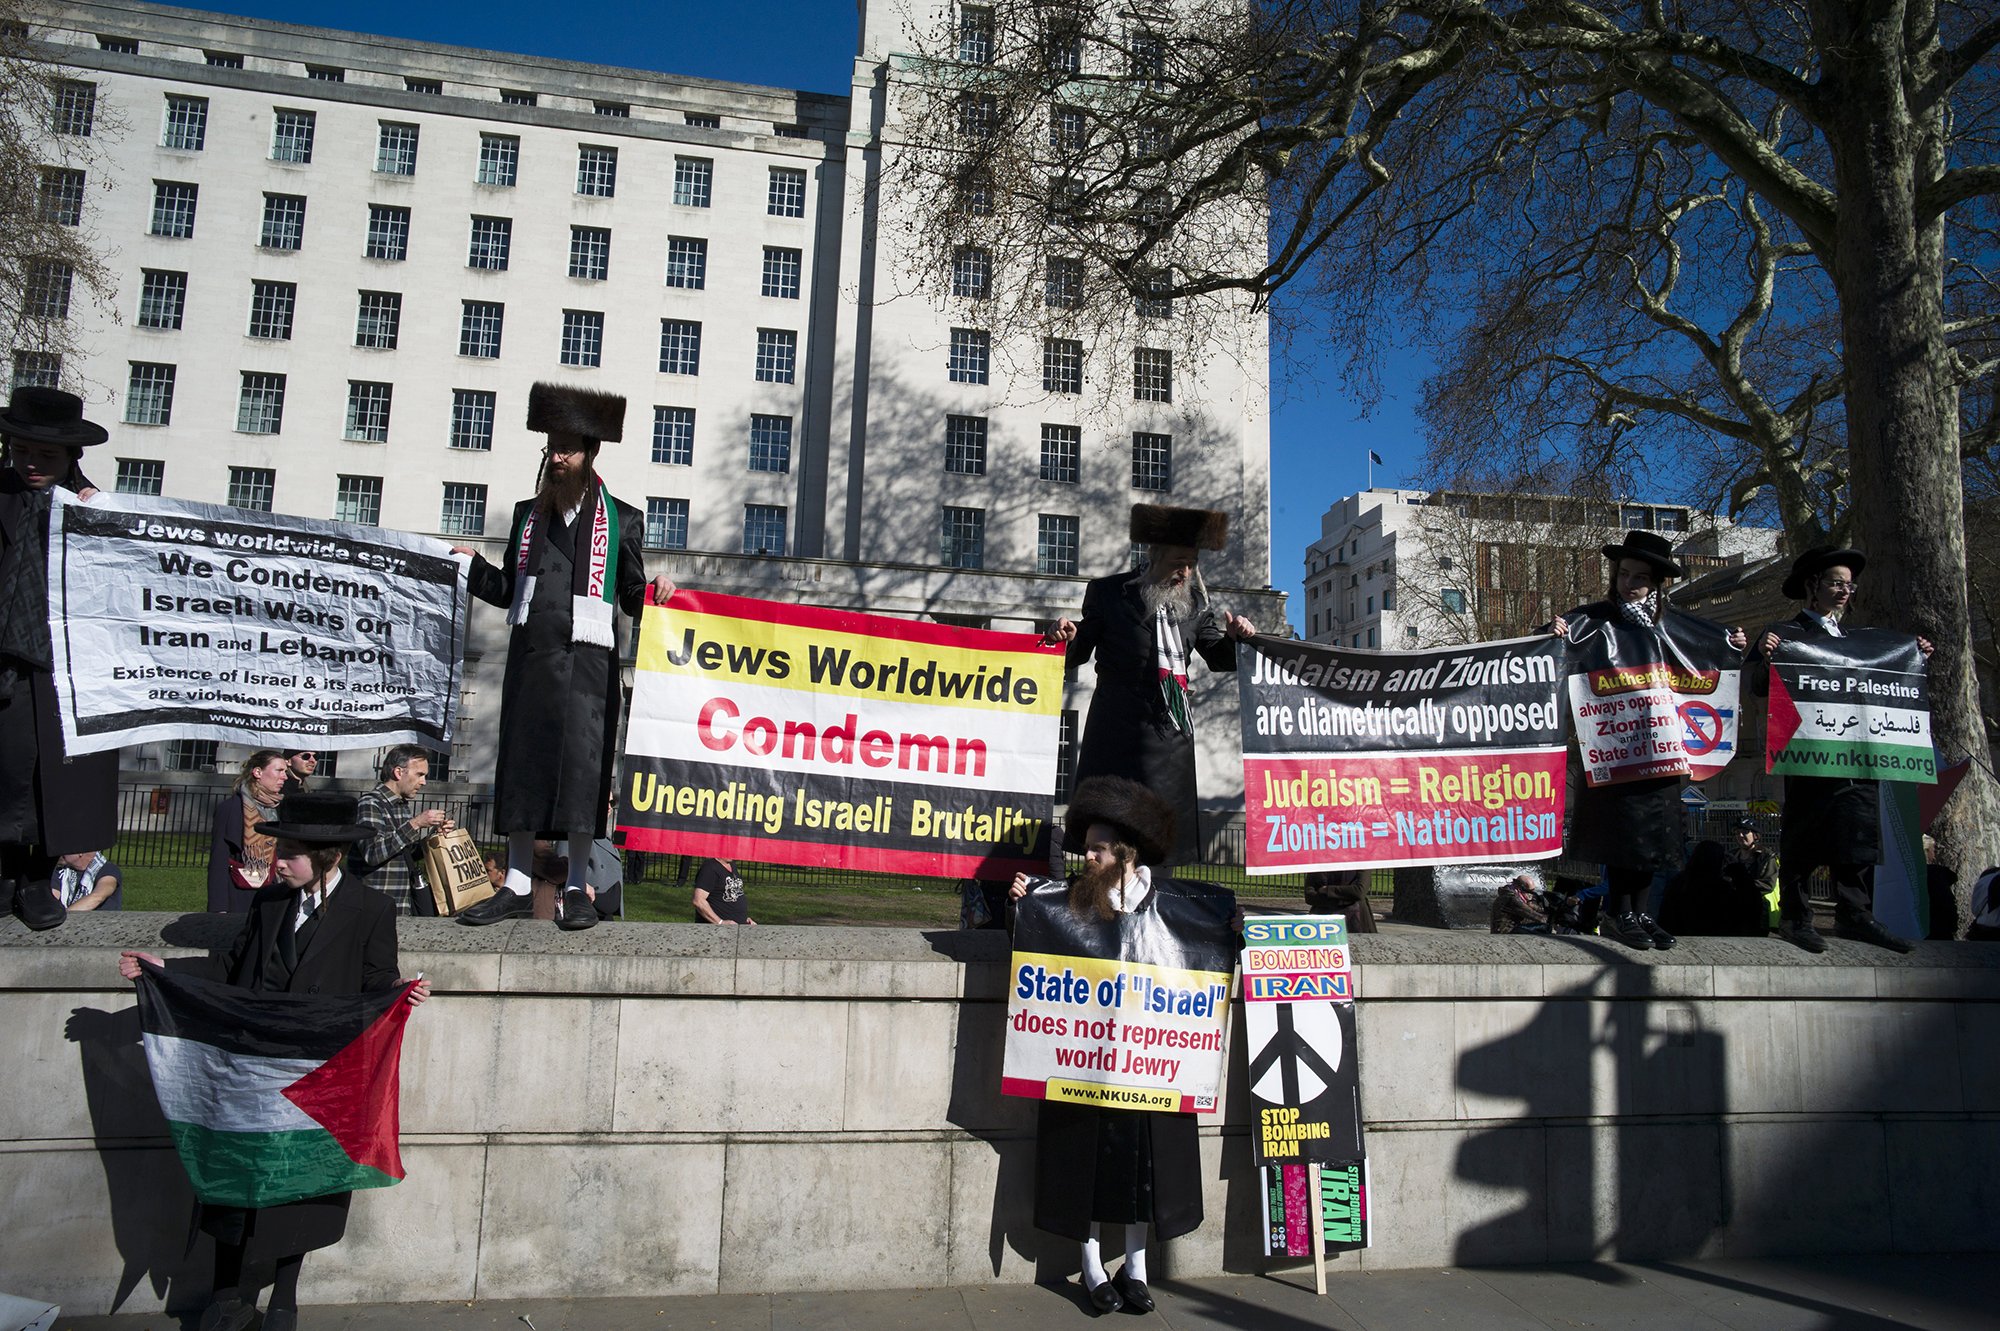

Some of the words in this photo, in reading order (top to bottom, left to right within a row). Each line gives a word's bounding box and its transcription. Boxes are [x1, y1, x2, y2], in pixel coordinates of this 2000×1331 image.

[129, 520, 206, 541] Jews
[215, 531, 350, 560] worldwide
[158, 552, 213, 578] We
[226, 559, 379, 600] Condemn
[143, 588, 252, 616] Israeli
[264, 600, 345, 630] Wars
[356, 617, 391, 636] on
[140, 626, 209, 647] Iran
[217, 639, 252, 651] and
[260, 632, 393, 667] Lebanon
[667, 628, 791, 679] Jews
[809, 644, 1038, 705] Worldwide
[1252, 646, 1381, 691] Judaism
[1382, 659, 1444, 692] and
[1440, 651, 1556, 688] Zionism
[113, 666, 213, 680] Existence
[219, 670, 238, 682] of
[244, 670, 296, 688] Israel
[303, 676, 316, 689] &
[324, 678, 346, 690] its
[351, 682, 417, 695] actions
[1798, 675, 1840, 691] Free
[1846, 677, 1920, 699] Palestine
[149, 689, 180, 700] are
[187, 689, 279, 709] violations
[285, 698, 308, 710] of
[309, 698, 385, 712] Judaism
[1580, 699, 1626, 717] always
[210, 714, 328, 733] www.NKUSA.org
[1256, 704, 1293, 736] are
[1298, 697, 1446, 743] diametrically
[1452, 693, 1559, 741] opposed
[1596, 715, 1675, 736] Zionism
[1815, 710, 1859, 736] عربية
[1869, 711, 1921, 736] فلسطين
[697, 697, 987, 777] Condemn
[1620, 733, 1640, 744] and
[1642, 731, 1658, 741] the
[1589, 746, 1628, 764] State
[1631, 745, 1647, 759] of
[1770, 750, 1934, 776] www.nkusa.org
[1263, 769, 1382, 808] Judaism
[1391, 778, 1409, 794] =
[1419, 764, 1556, 809] Religion,
[631, 772, 784, 833] Unending
[794, 789, 892, 834] Israeli
[911, 800, 1041, 854] Brutality
[1266, 814, 1366, 852] Zionism
[1372, 822, 1389, 837] =
[1396, 806, 1556, 846] Nationalism
[453, 858, 487, 883] TRADE
[1247, 923, 1341, 940] STOP
[1249, 949, 1344, 970] BOMBING
[1017, 965, 1089, 1005] State
[1098, 973, 1126, 1008] of
[1133, 976, 1226, 1018] "Israel"
[1251, 975, 1349, 998] IRAN
[1013, 1009, 1067, 1036] does
[1074, 1018, 1116, 1041] not
[1122, 1024, 1221, 1050] represent
[1055, 1047, 1116, 1072] world
[1122, 1049, 1180, 1083] Jewry
[1061, 1087, 1172, 1107] www.NKUSA.org
[1261, 1108, 1300, 1125] STOP
[1262, 1122, 1330, 1141] BOMBING
[1263, 1140, 1299, 1157] IRAN
[1348, 1165, 1359, 1192] STOP
[1321, 1169, 1352, 1242] IRAN
[1350, 1193, 1362, 1242] BOMBING
